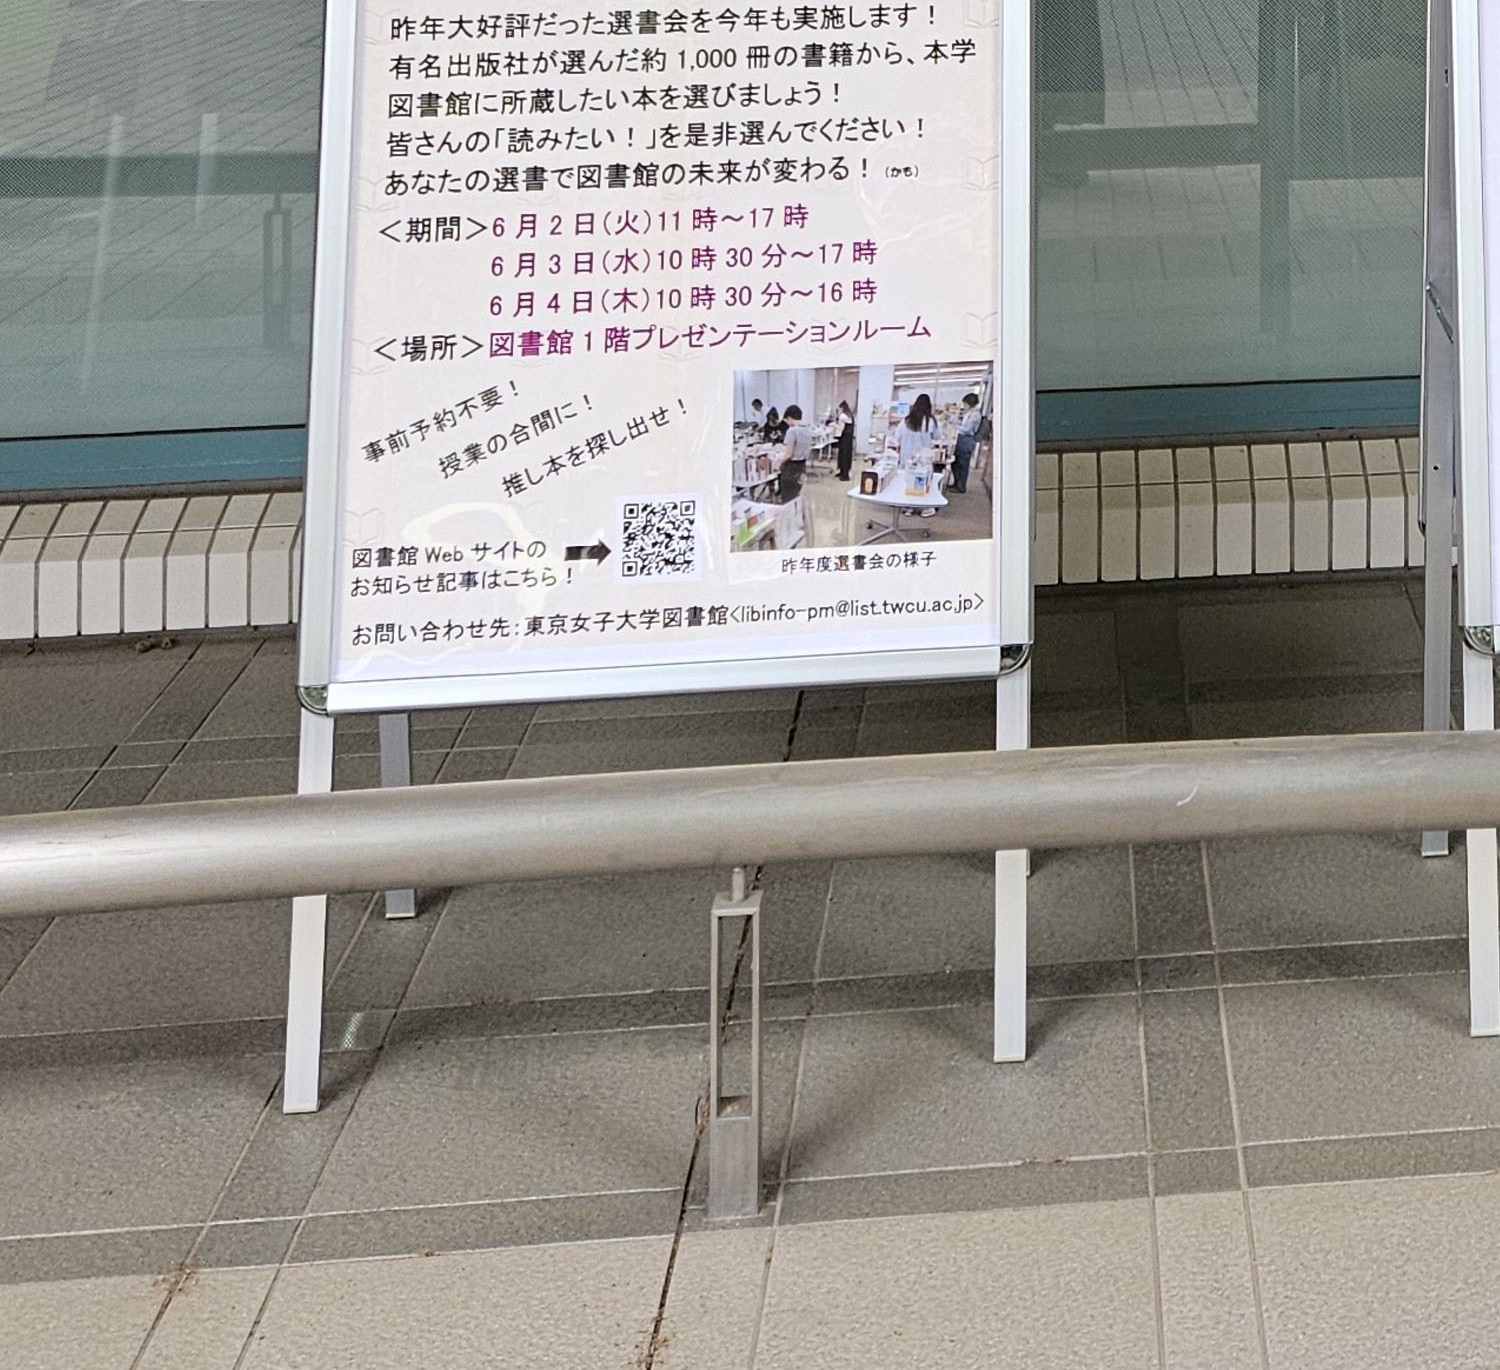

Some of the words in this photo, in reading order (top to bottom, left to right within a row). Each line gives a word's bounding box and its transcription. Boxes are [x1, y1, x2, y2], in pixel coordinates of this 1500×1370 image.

[390, 2, 934, 42] 昨年大好評だった選書会を今年も実施します！
[388, 80, 839, 119] 図書館に所蔵したい本を選びましょう！
[386, 116, 923, 158] 皆さんの「読みたい！」を是非選んでください！
[384, 155, 867, 197] あなたの選書で図書館の未来が変わる！
[362, 378, 520, 465] 事前予約不要！
[436, 393, 593, 480] 授業の合間に！
[500, 397, 688, 498] 推し本を探し出せ！
[350, 566, 572, 598] お知らせ記事はこちら！
[781, 551, 937, 573] 昨年度選書会の様子
